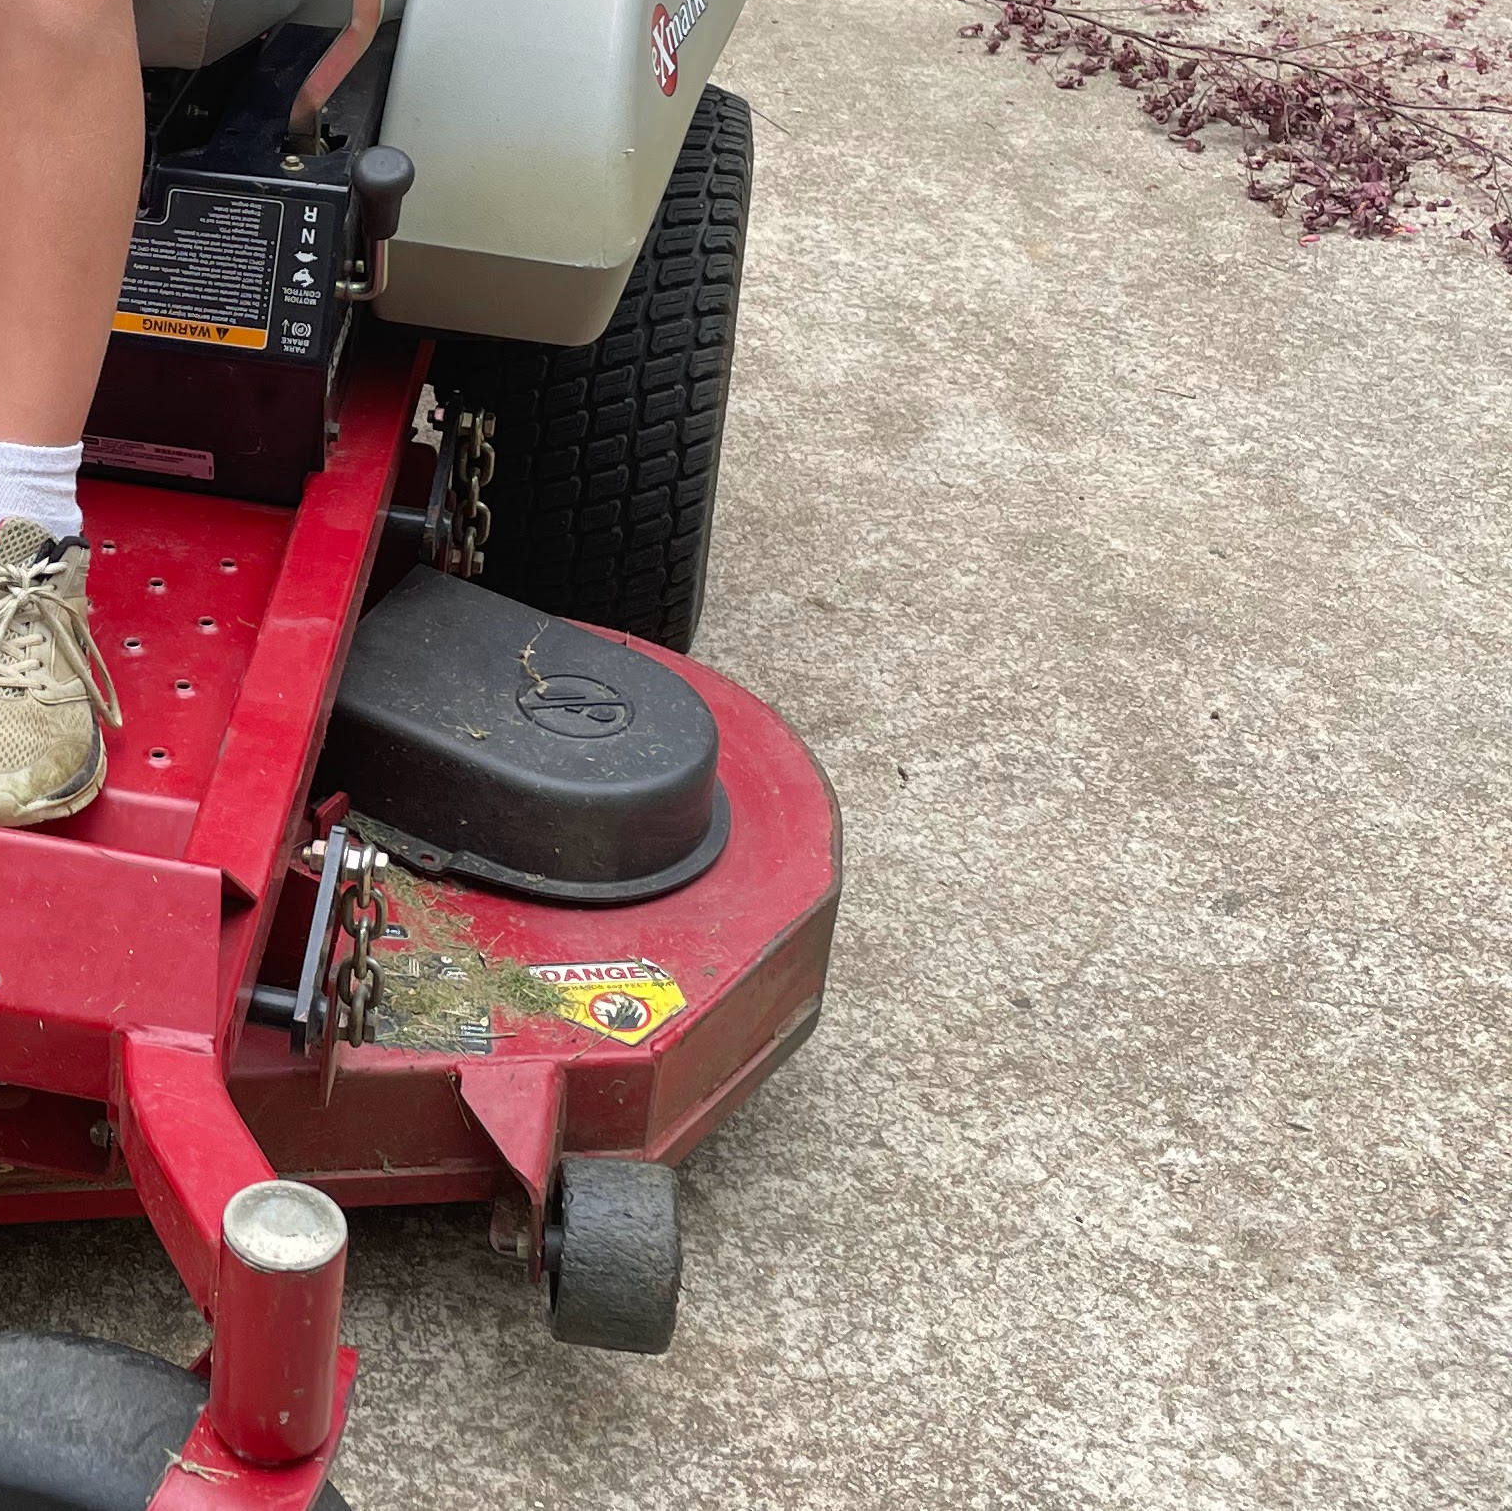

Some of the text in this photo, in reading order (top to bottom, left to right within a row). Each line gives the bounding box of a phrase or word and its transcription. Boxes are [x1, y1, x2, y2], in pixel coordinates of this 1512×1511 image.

[303, 206, 318, 223] R
[301, 228, 316, 245] N
[281, 287, 321, 299] CONTROL
[284, 295, 317, 306] MOTION
[142, 318, 211, 339] WARNING
[280, 336, 310, 348] BRAKE
[283, 344, 306, 355] PARK
